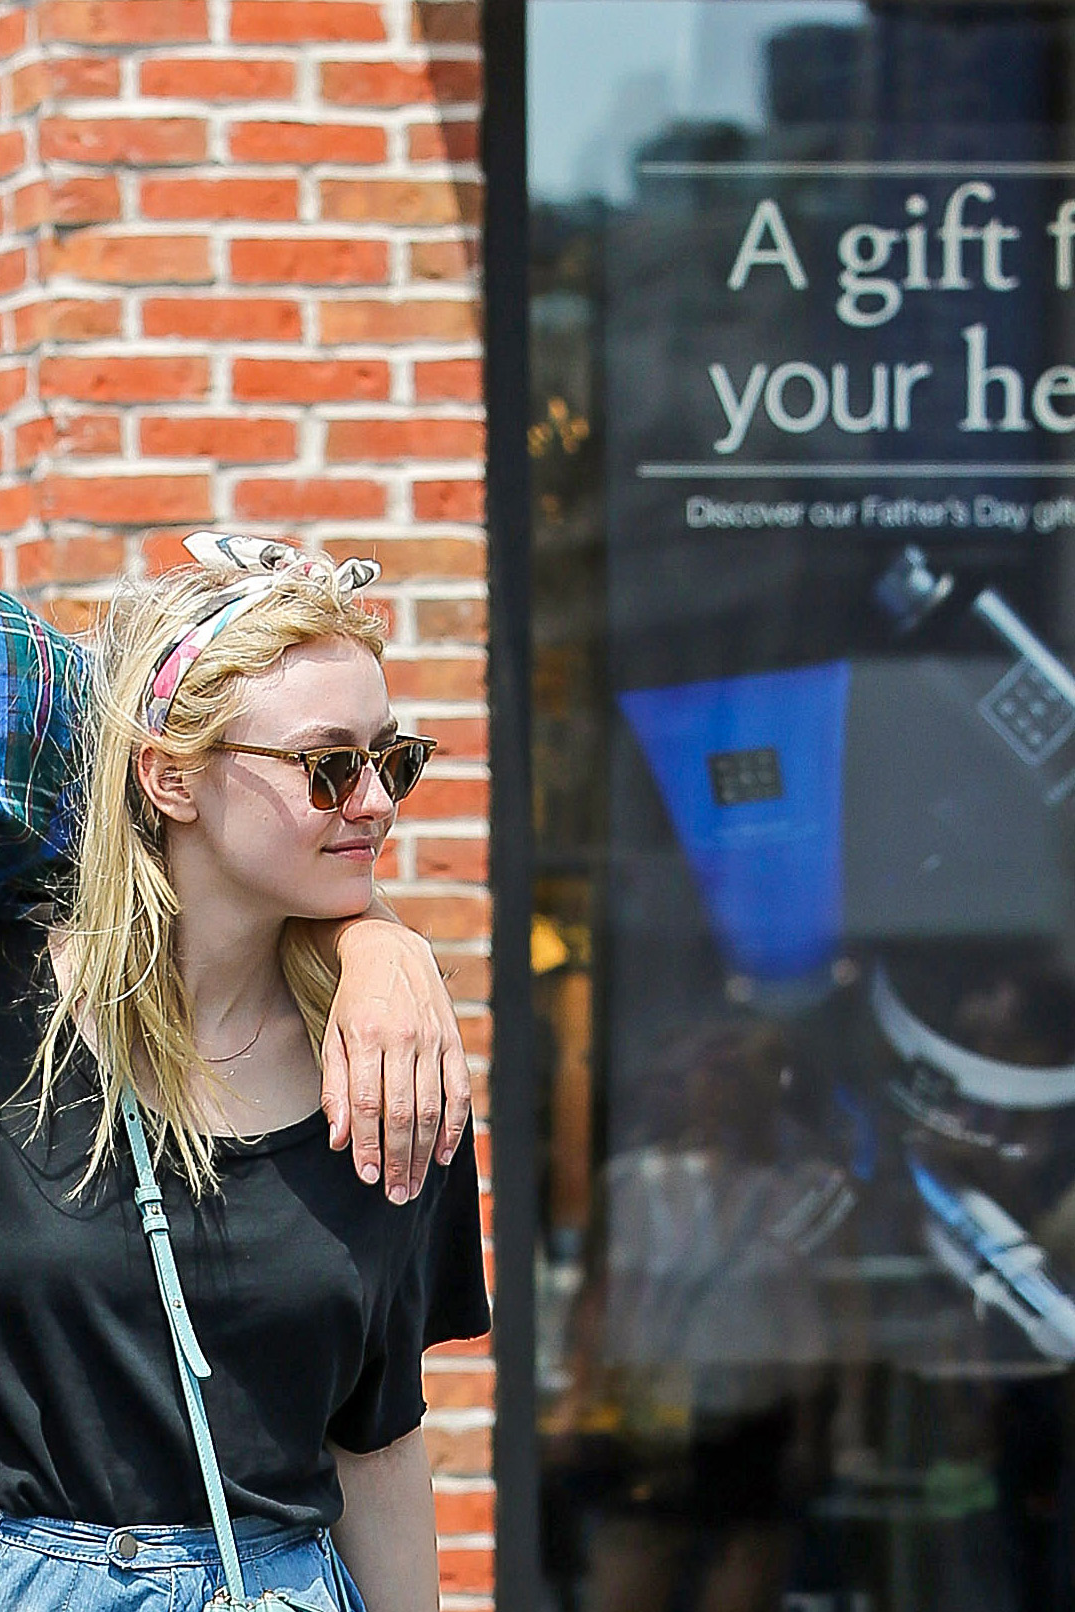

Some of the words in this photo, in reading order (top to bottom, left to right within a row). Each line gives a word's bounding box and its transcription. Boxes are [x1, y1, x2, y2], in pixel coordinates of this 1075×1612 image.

[728, 199, 808, 290] A
[836, 181, 1021, 327] gift
[709, 361, 932, 454] your
[686, 496, 804, 528] Discover
[807, 501, 858, 528] our
[861, 495, 971, 528] Father's
[974, 495, 1025, 532] Day
